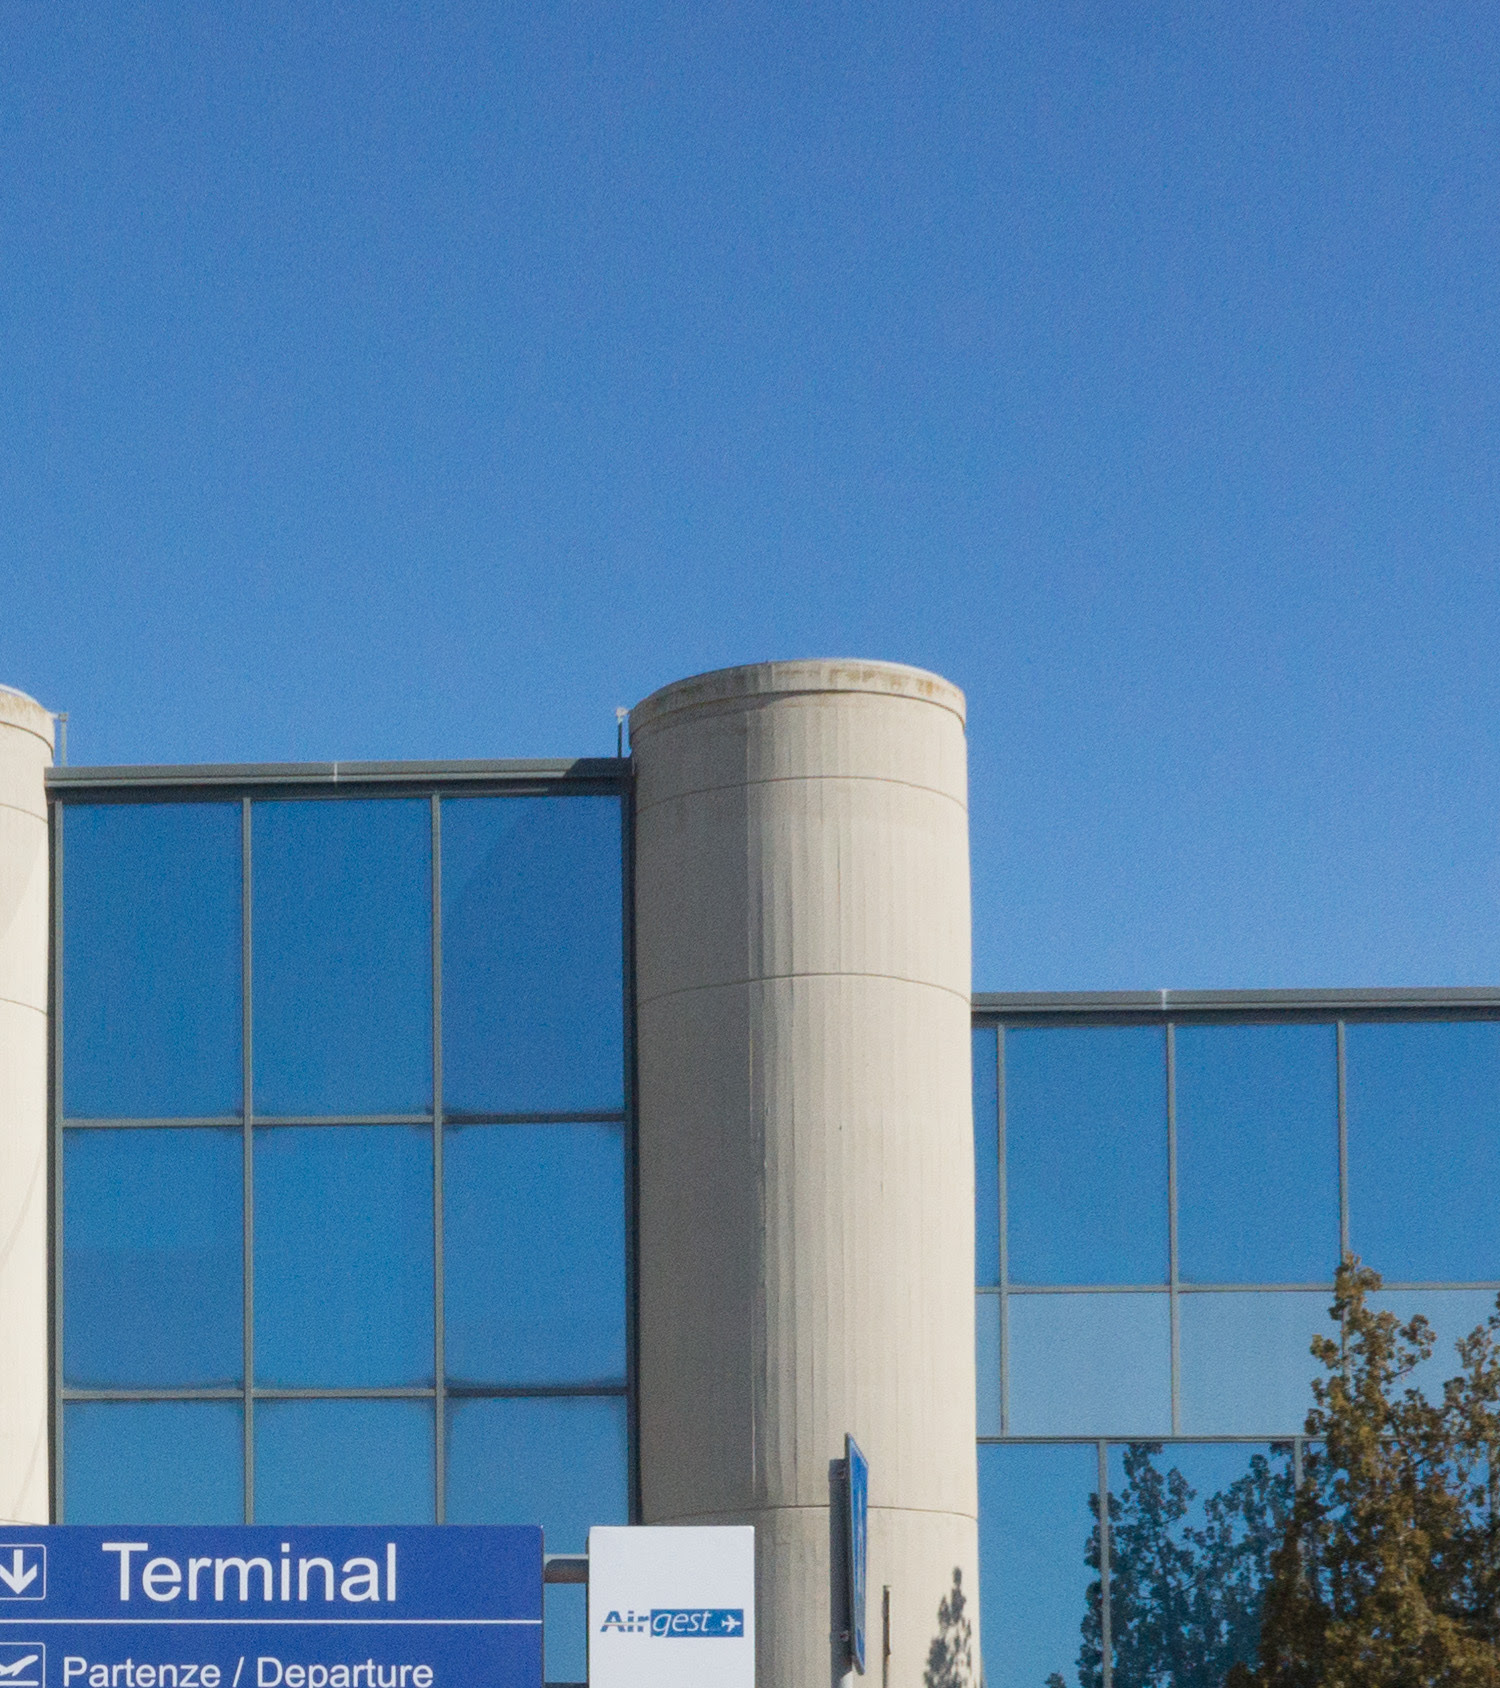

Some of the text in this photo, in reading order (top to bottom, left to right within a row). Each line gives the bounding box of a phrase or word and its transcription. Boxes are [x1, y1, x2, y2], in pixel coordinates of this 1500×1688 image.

[101, 1541, 397, 1602] Terminal
[600, 1609, 713, 1638] Airgest
[63, 1656, 221, 1688] Partenze
[232, 1656, 245, 1688] /
